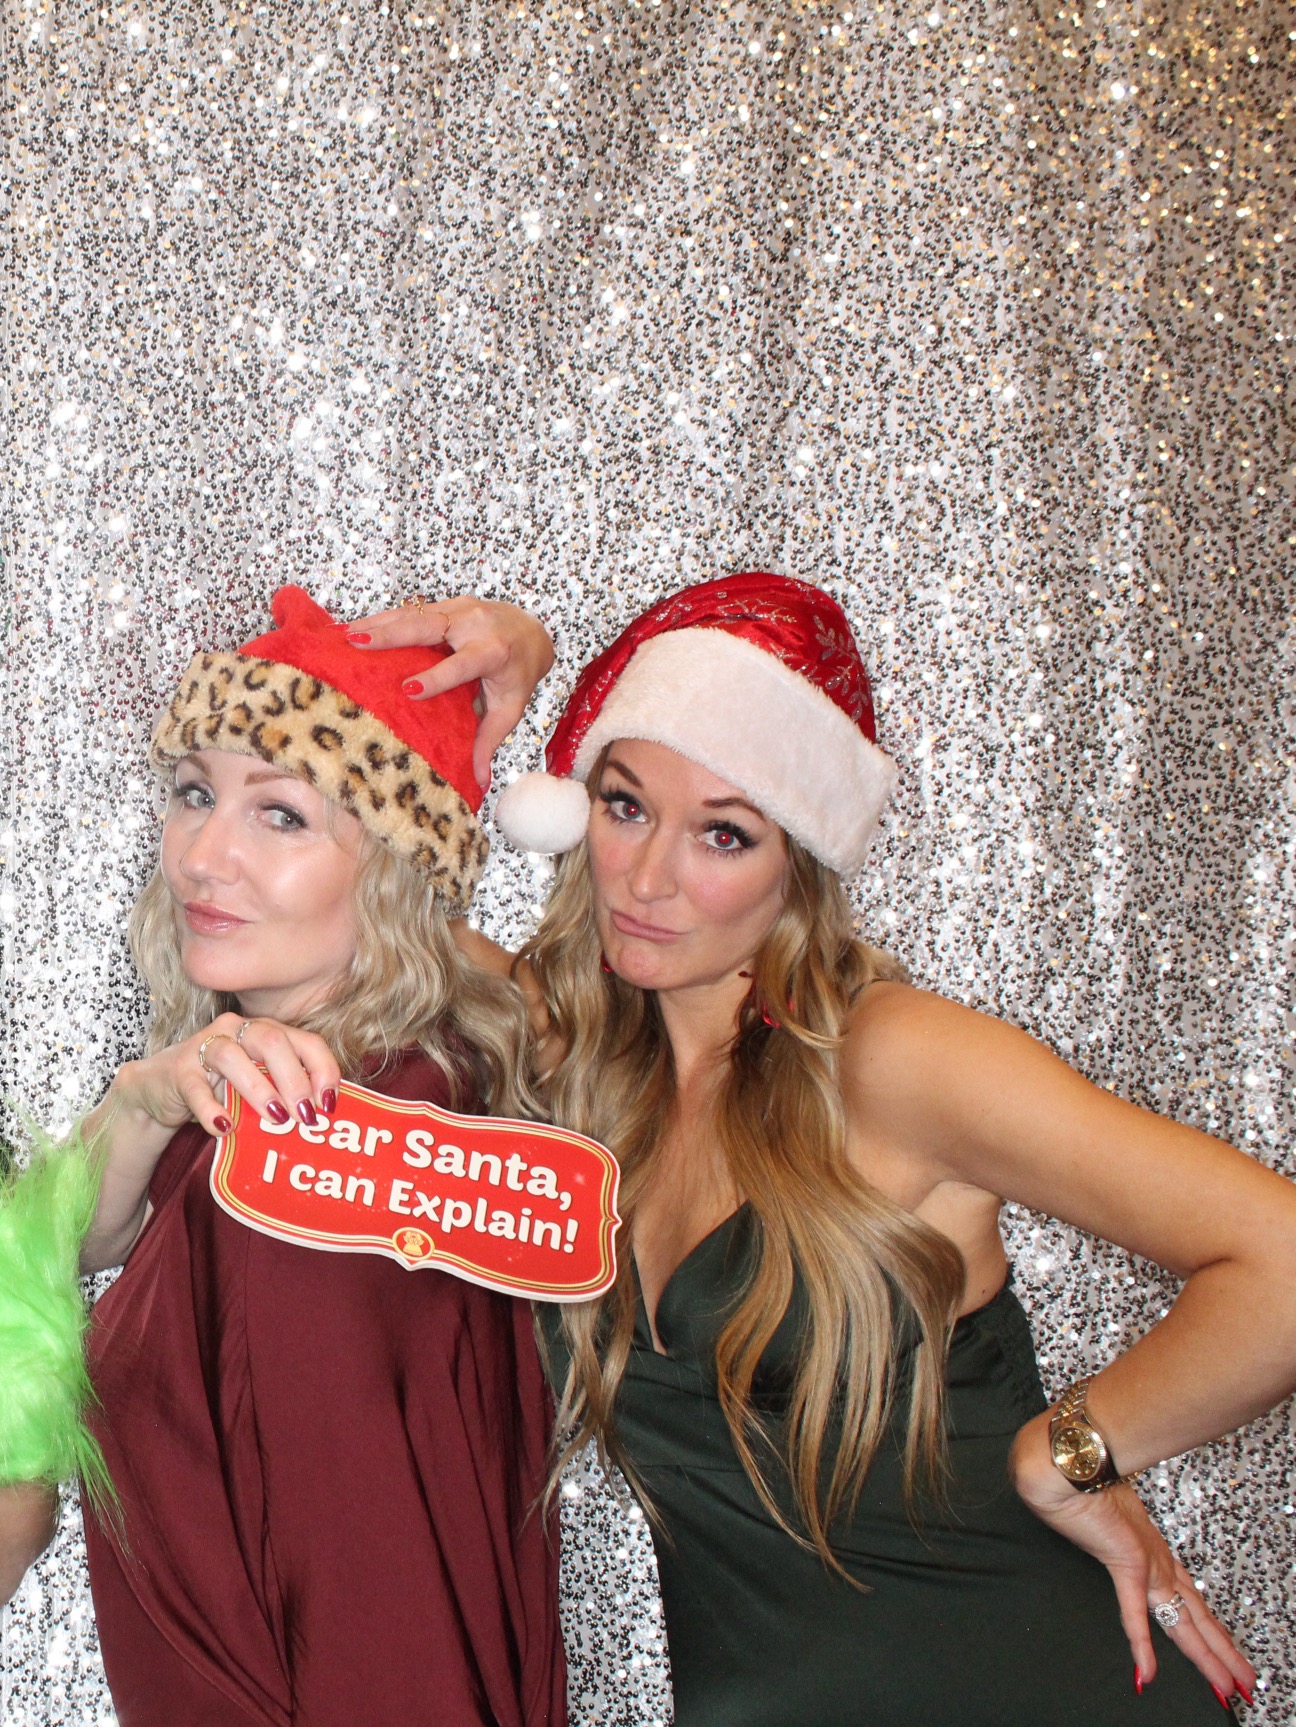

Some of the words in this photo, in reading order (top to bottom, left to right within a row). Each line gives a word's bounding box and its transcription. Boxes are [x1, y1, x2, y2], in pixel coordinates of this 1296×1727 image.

[262, 1149, 279, 1183] I
[289, 1163, 376, 1207] can
[388, 1179, 579, 1254] Explain!
[402, 1128, 572, 1211] Santa,
